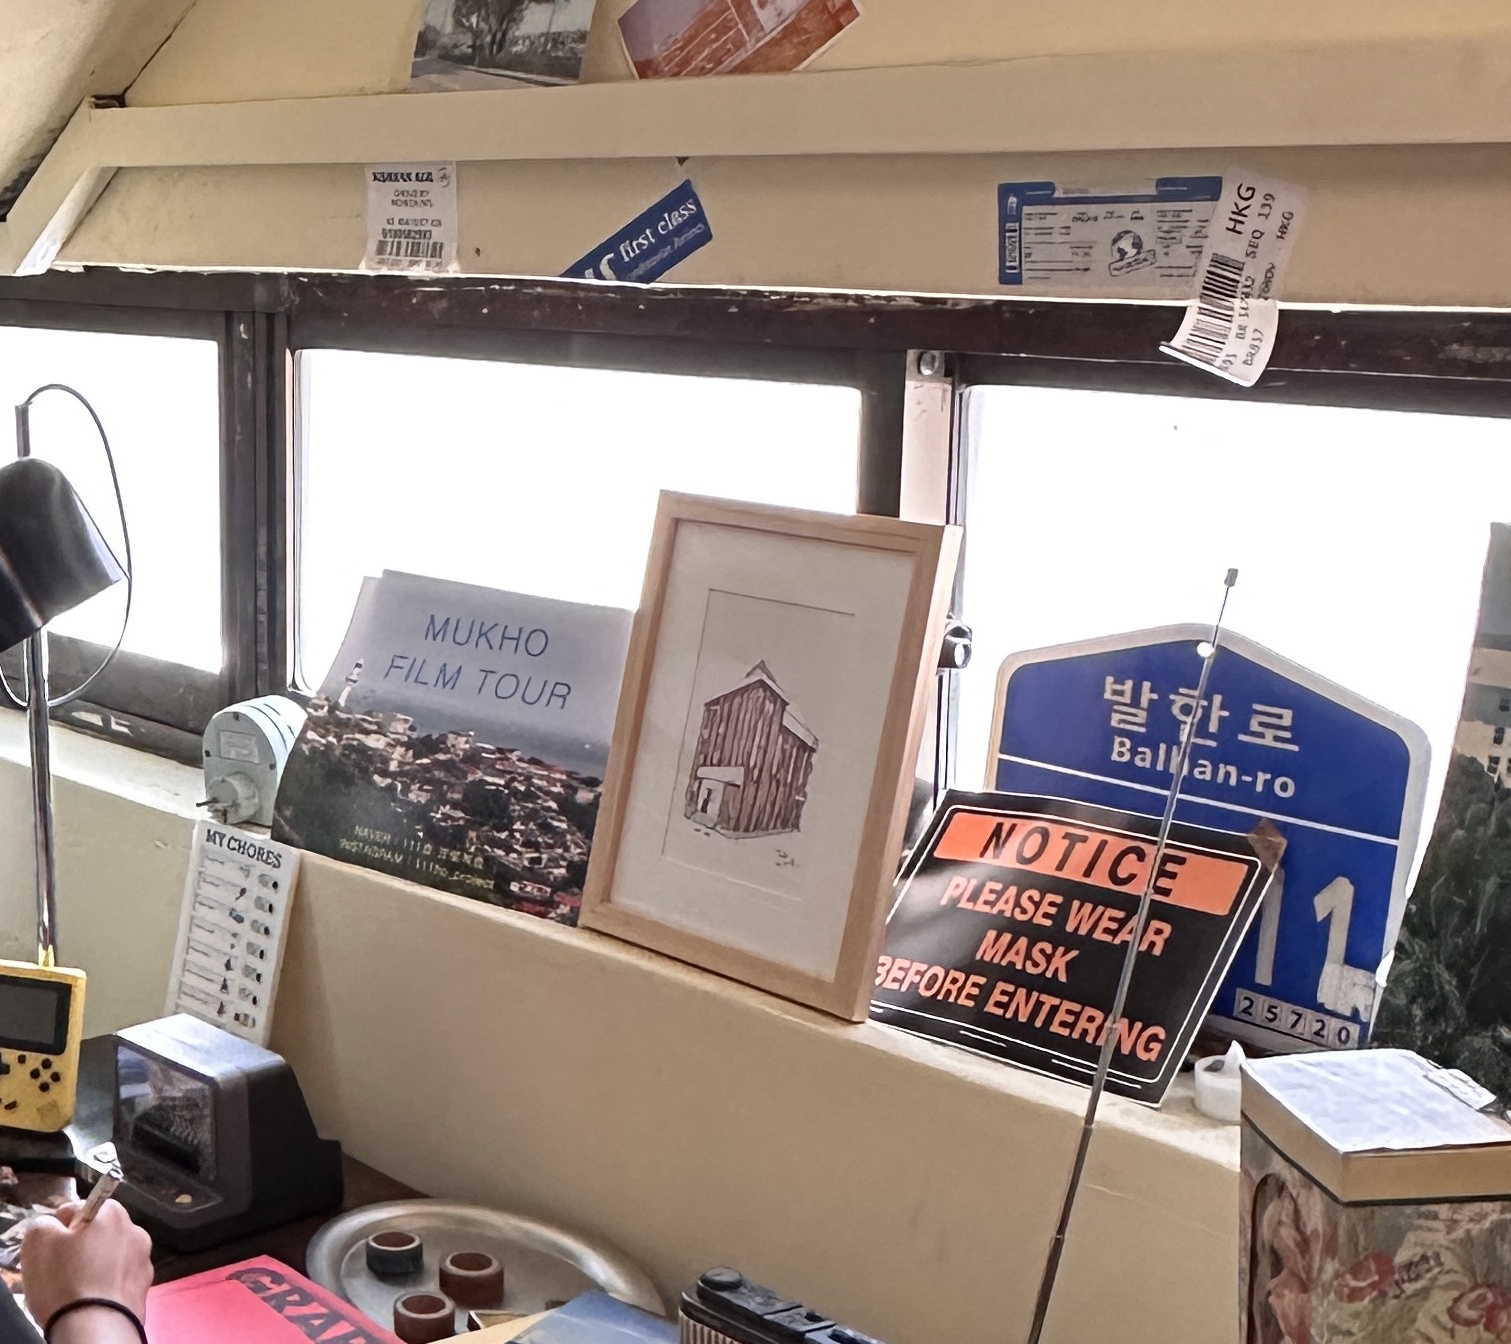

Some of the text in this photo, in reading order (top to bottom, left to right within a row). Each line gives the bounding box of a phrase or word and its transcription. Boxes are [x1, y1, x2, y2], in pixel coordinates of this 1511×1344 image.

[619, 198, 698, 263] first class
[1225, 182, 1257, 236] HKG
[425, 613, 550, 658] MUKHO
[383, 653, 573, 711] FILM TOUR
[206, 828, 283, 870] MY CHORES
[979, 821, 1187, 898] NOTICE
[940, 875, 1173, 957] PLEASE WEAR
[875, 954, 988, 1008] BEFORE
[975, 929, 1080, 983] MASK
[1236, 995, 1352, 1045] 25720
